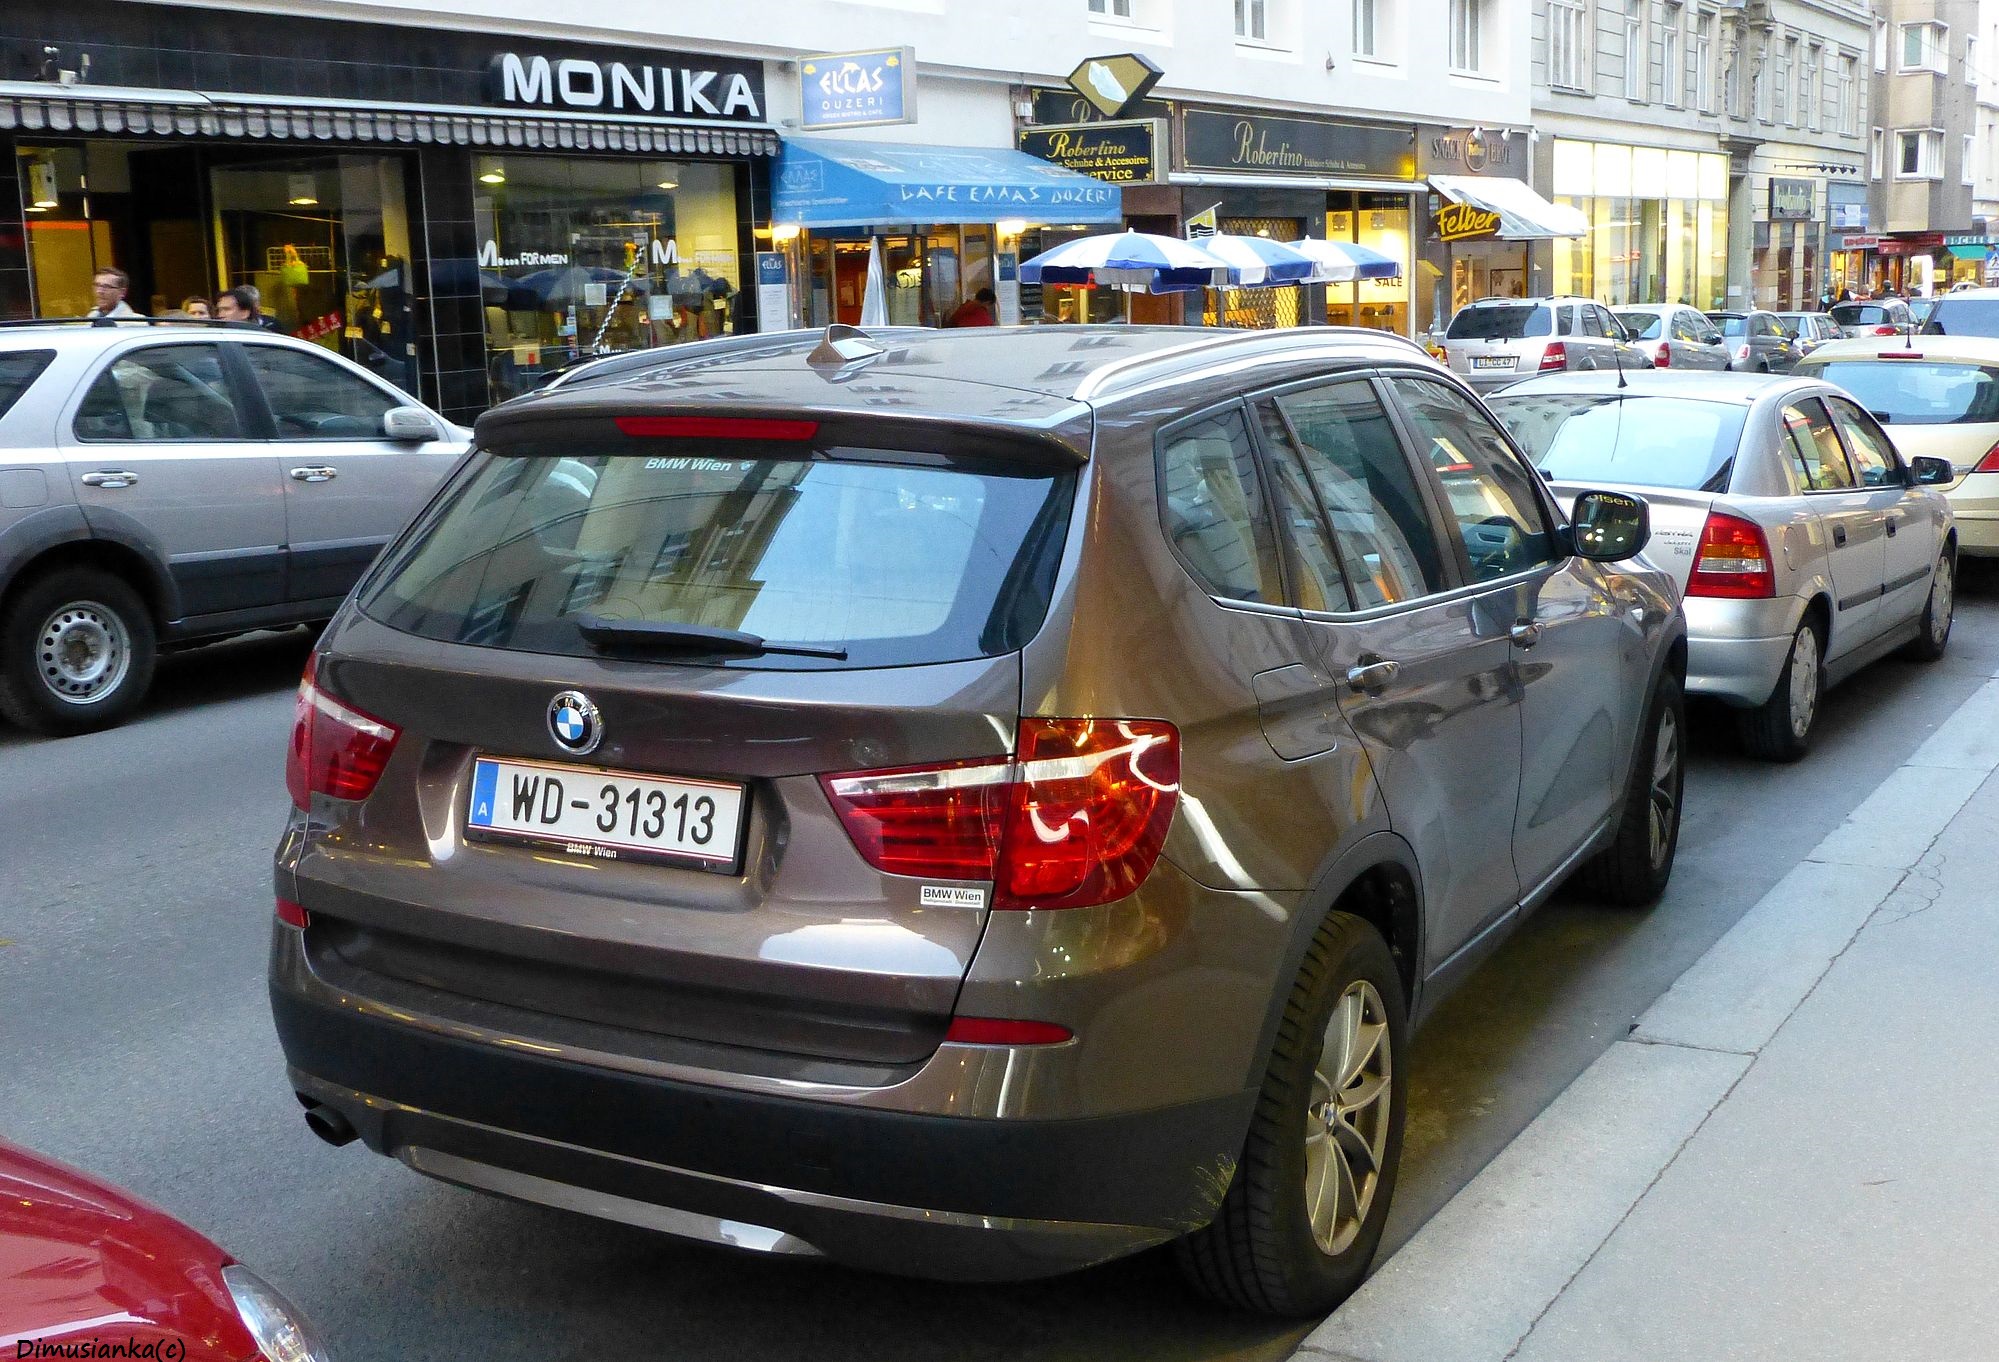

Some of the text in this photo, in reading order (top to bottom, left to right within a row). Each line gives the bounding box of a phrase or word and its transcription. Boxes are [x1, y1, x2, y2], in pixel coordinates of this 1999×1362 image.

[501, 53, 760, 117] MONIKA
[822, 97, 883, 110] OUZERI
[1046, 132, 1126, 158] Robertino
[1232, 120, 1302, 167] Robertino
[1095, 157, 1103, 167] &
[1087, 167, 1133, 182] ervice
[1435, 201, 1502, 236] Felber
[521, 251, 539, 265] FOR
[540, 254, 568, 265] MEN
[645, 458, 732, 471] BMW Wien
[477, 801, 489, 817] A
[512, 773, 716, 845] WD-31313
[566, 842, 617, 859] BMW Wien
[923, 888, 981, 901] BMW Wien
